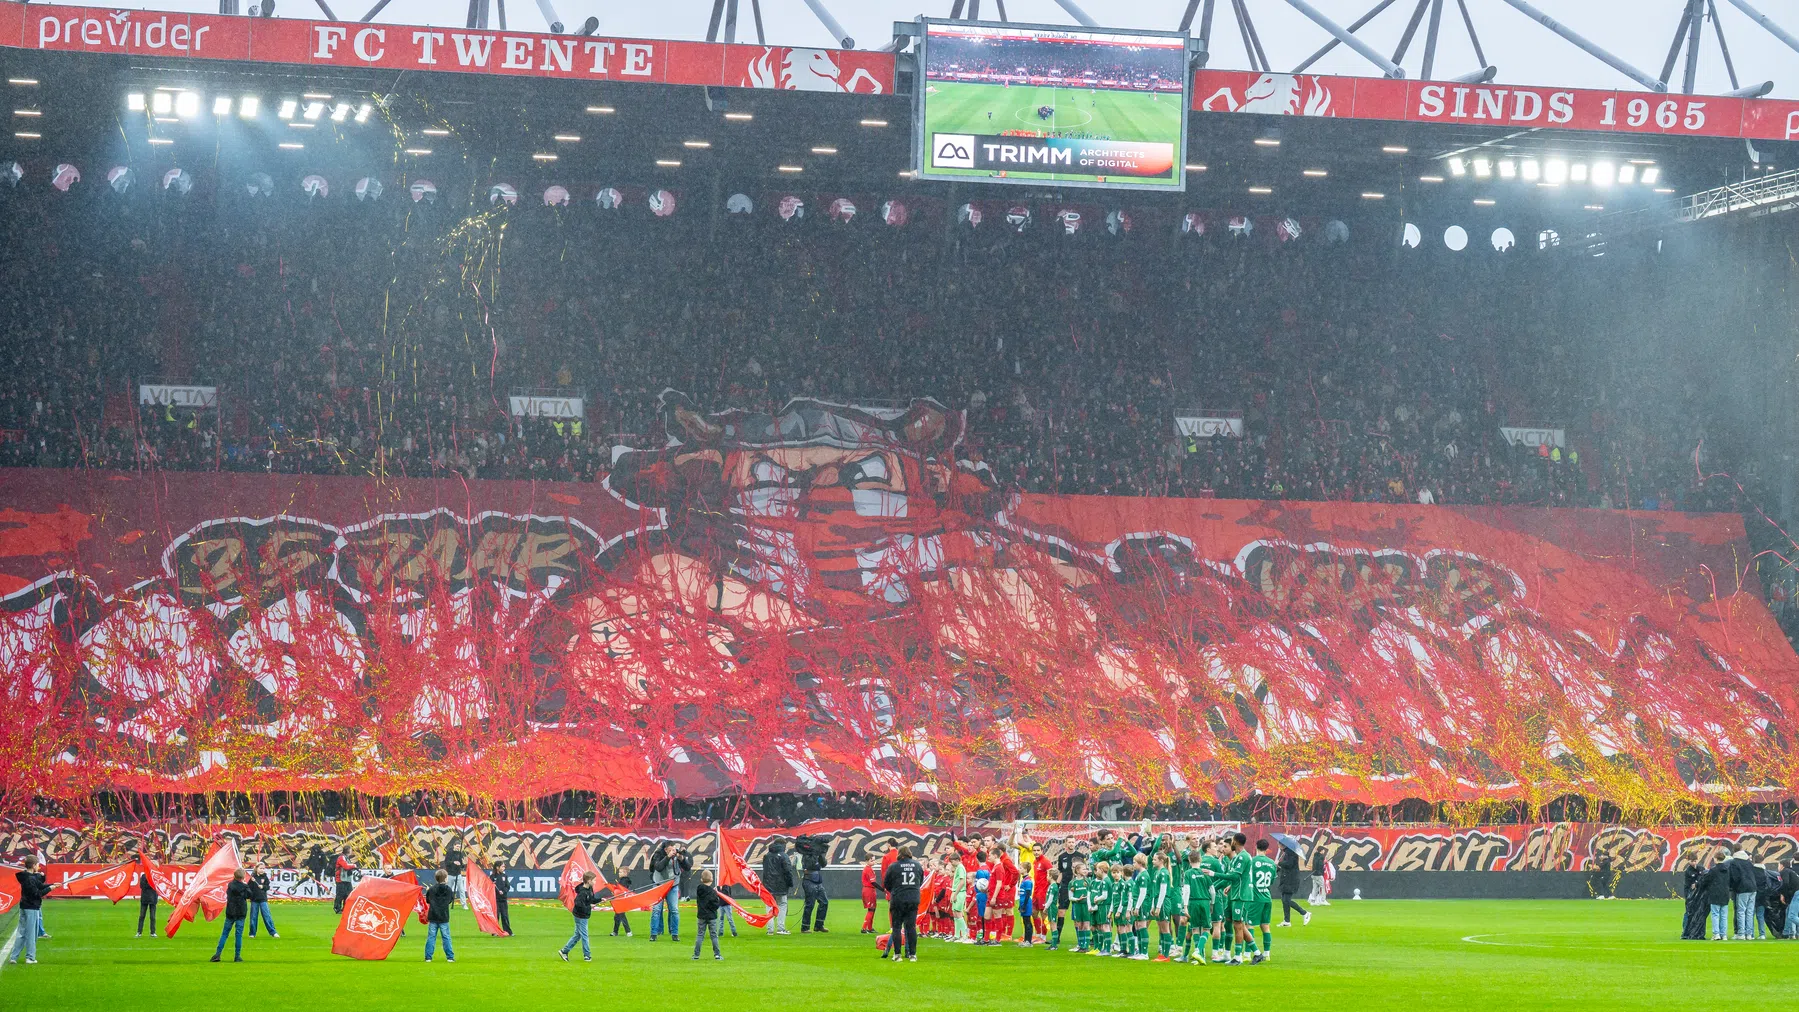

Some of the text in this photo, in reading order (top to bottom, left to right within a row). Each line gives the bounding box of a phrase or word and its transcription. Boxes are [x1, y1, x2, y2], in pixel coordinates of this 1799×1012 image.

[39, 10, 210, 51] previder
[314, 25, 656, 76] FC TWENTE
[1418, 85, 1706, 130] SINDS 1965
[983, 143, 1072, 166] TRIMM
[1079, 149, 1145, 159] ARCHITECTS
[1079, 159, 1138, 169] OF DIGITAL
[149, 387, 206, 405] VICTA
[519, 399, 574, 416] VICTA
[1183, 420, 1235, 436] VICTA
[901, 872, 916, 886] 12
[1255, 870, 1272, 888] 26
